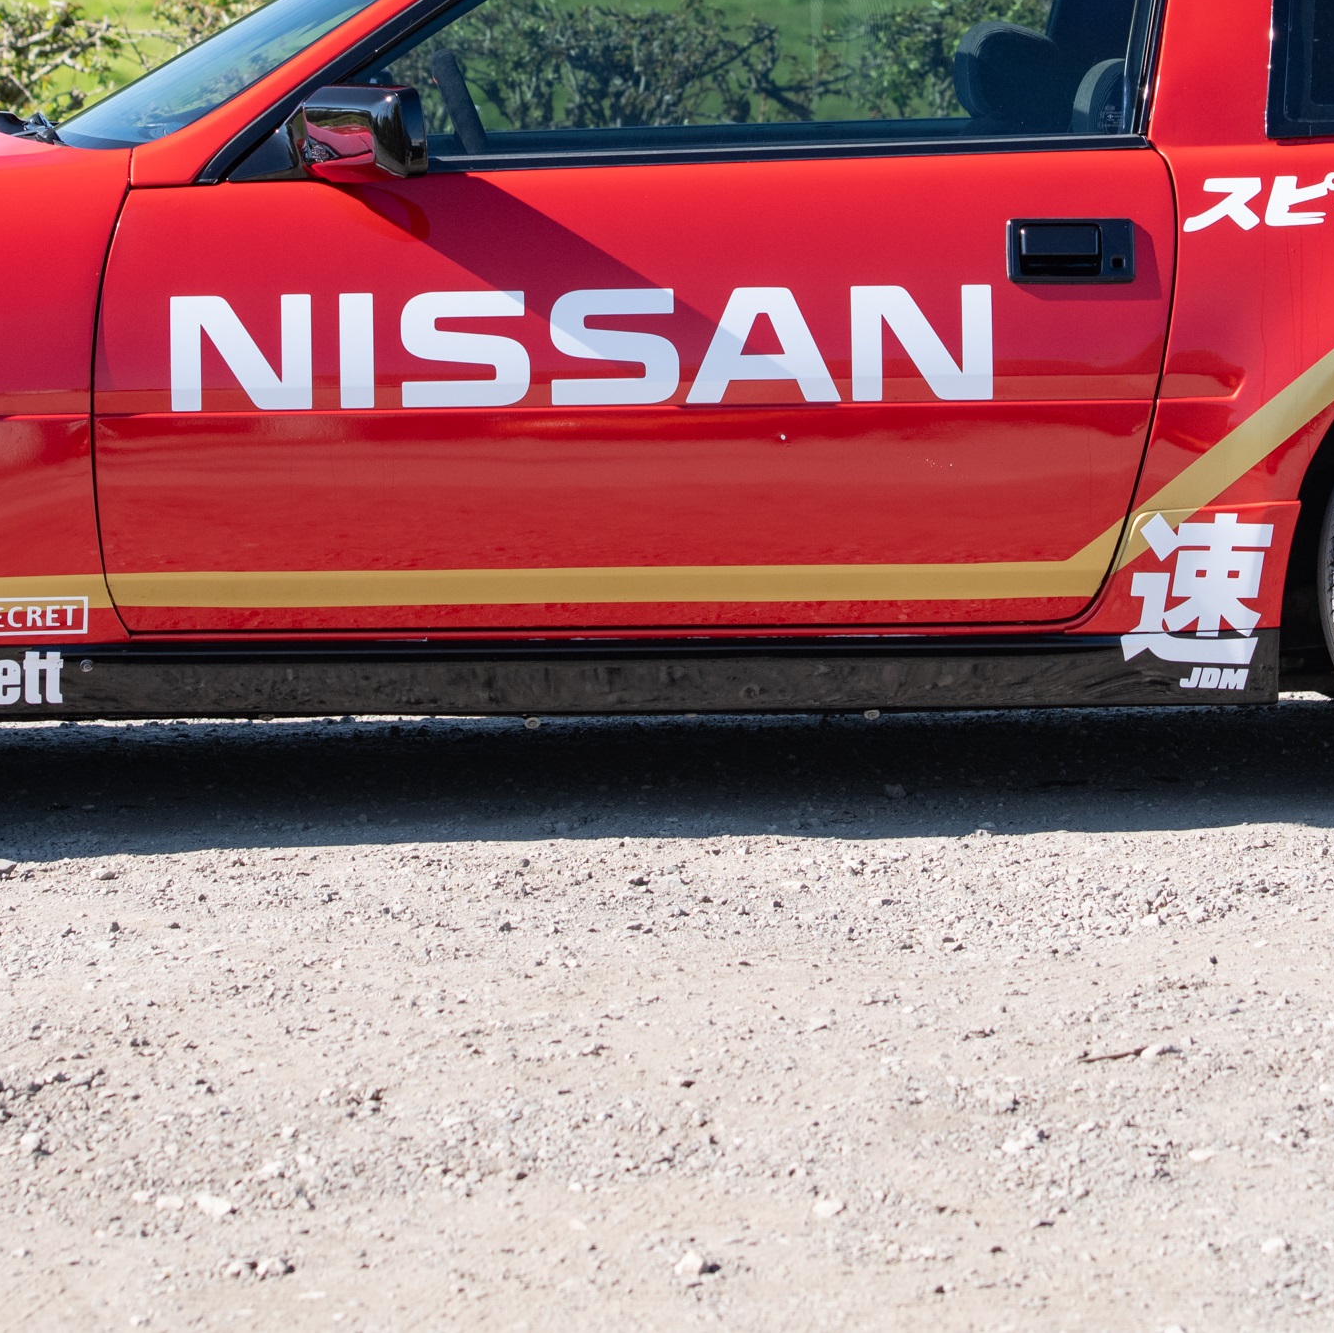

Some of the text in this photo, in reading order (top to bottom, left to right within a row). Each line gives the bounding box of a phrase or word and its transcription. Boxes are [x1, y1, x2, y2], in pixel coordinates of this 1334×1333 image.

[169, 284, 994, 411] NISSAN
[1120, 512, 1275, 664] 速
[1179, 667, 1250, 690] JDM
